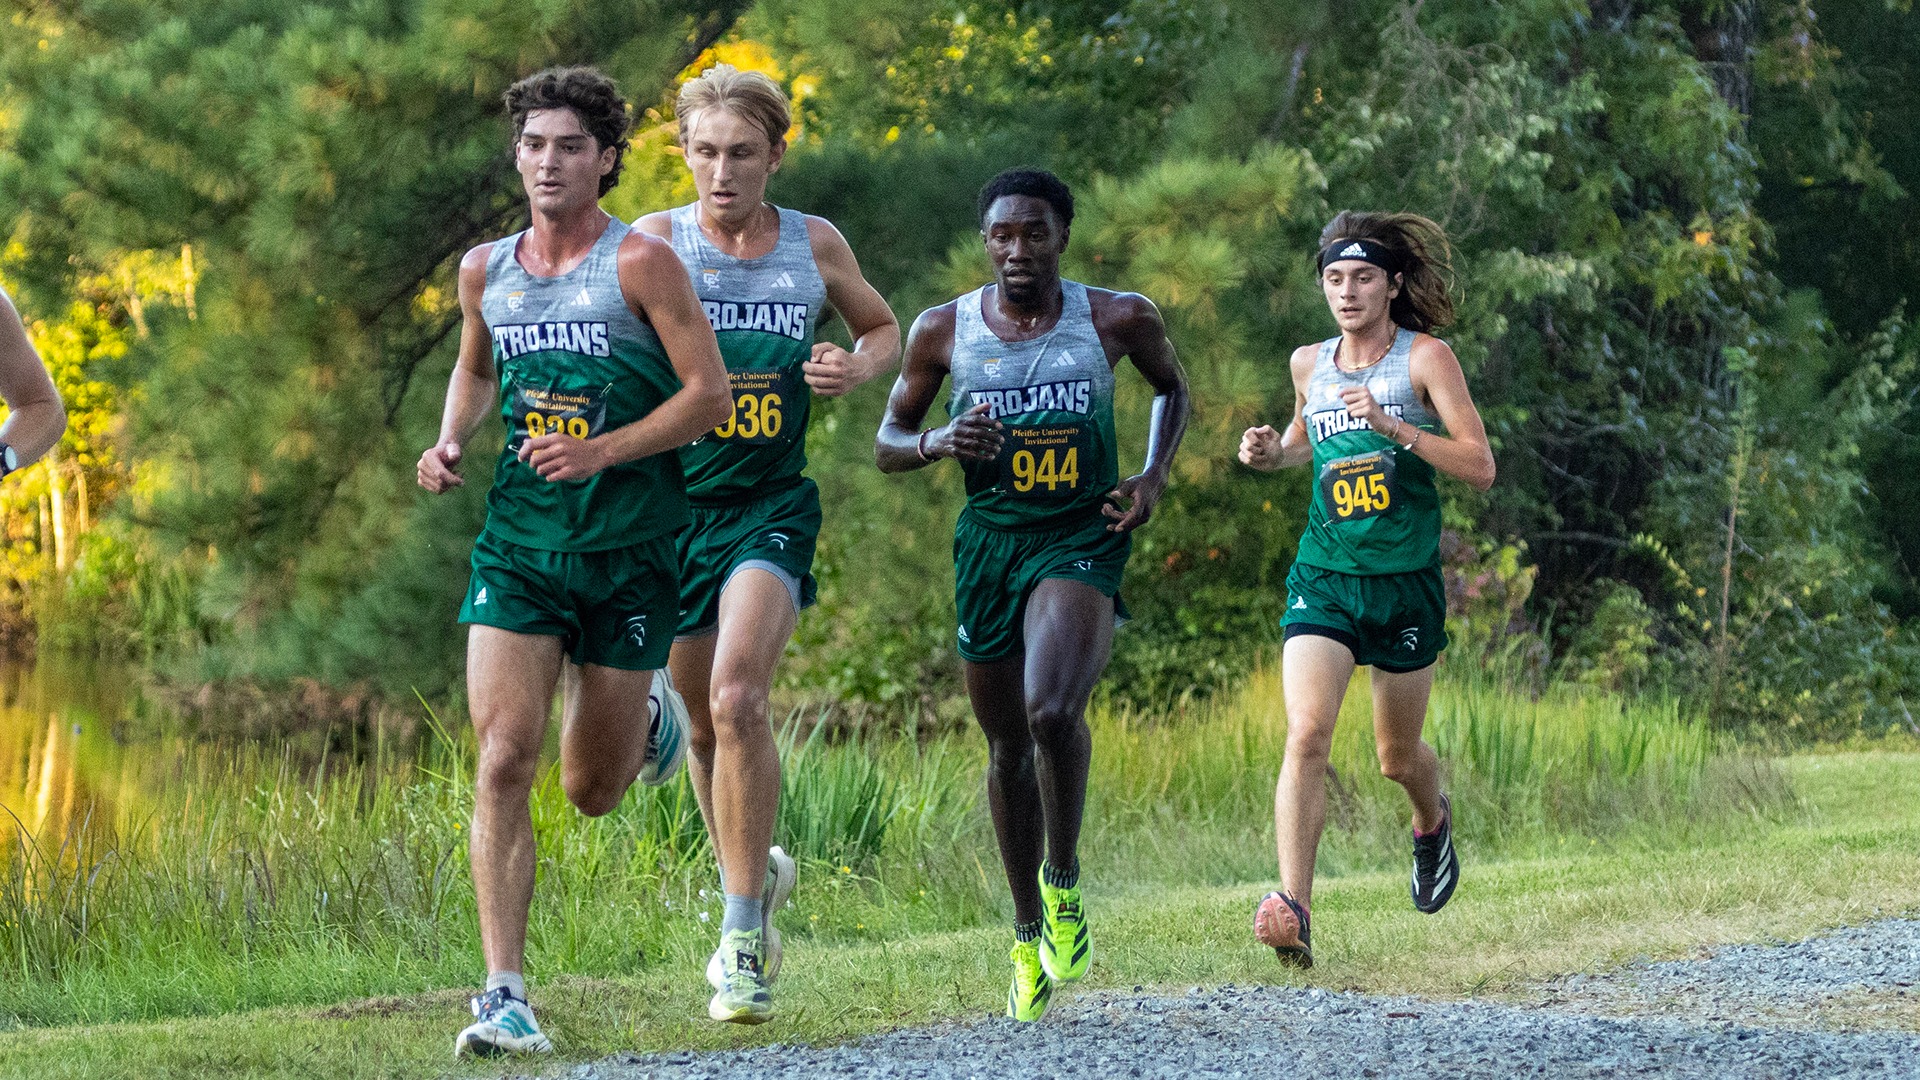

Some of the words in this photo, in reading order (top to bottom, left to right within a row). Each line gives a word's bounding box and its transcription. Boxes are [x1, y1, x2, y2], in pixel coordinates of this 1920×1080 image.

[700, 300, 808, 341] ROJANS
[493, 322, 611, 361] TROJANS
[730, 381, 770, 389] nvitational
[742, 372, 781, 381] University
[535, 400, 578, 412] Invitational
[552, 393, 591, 405] University
[969, 380, 1091, 420] TROJANS
[1012, 429, 1040, 437] Pfeiffer
[1041, 427, 1079, 436] University
[1311, 404, 1404, 444] TROJAS
[1024, 436, 1068, 445] Invitational
[1012, 447, 1079, 492] 944
[1332, 473, 1390, 517] 945
